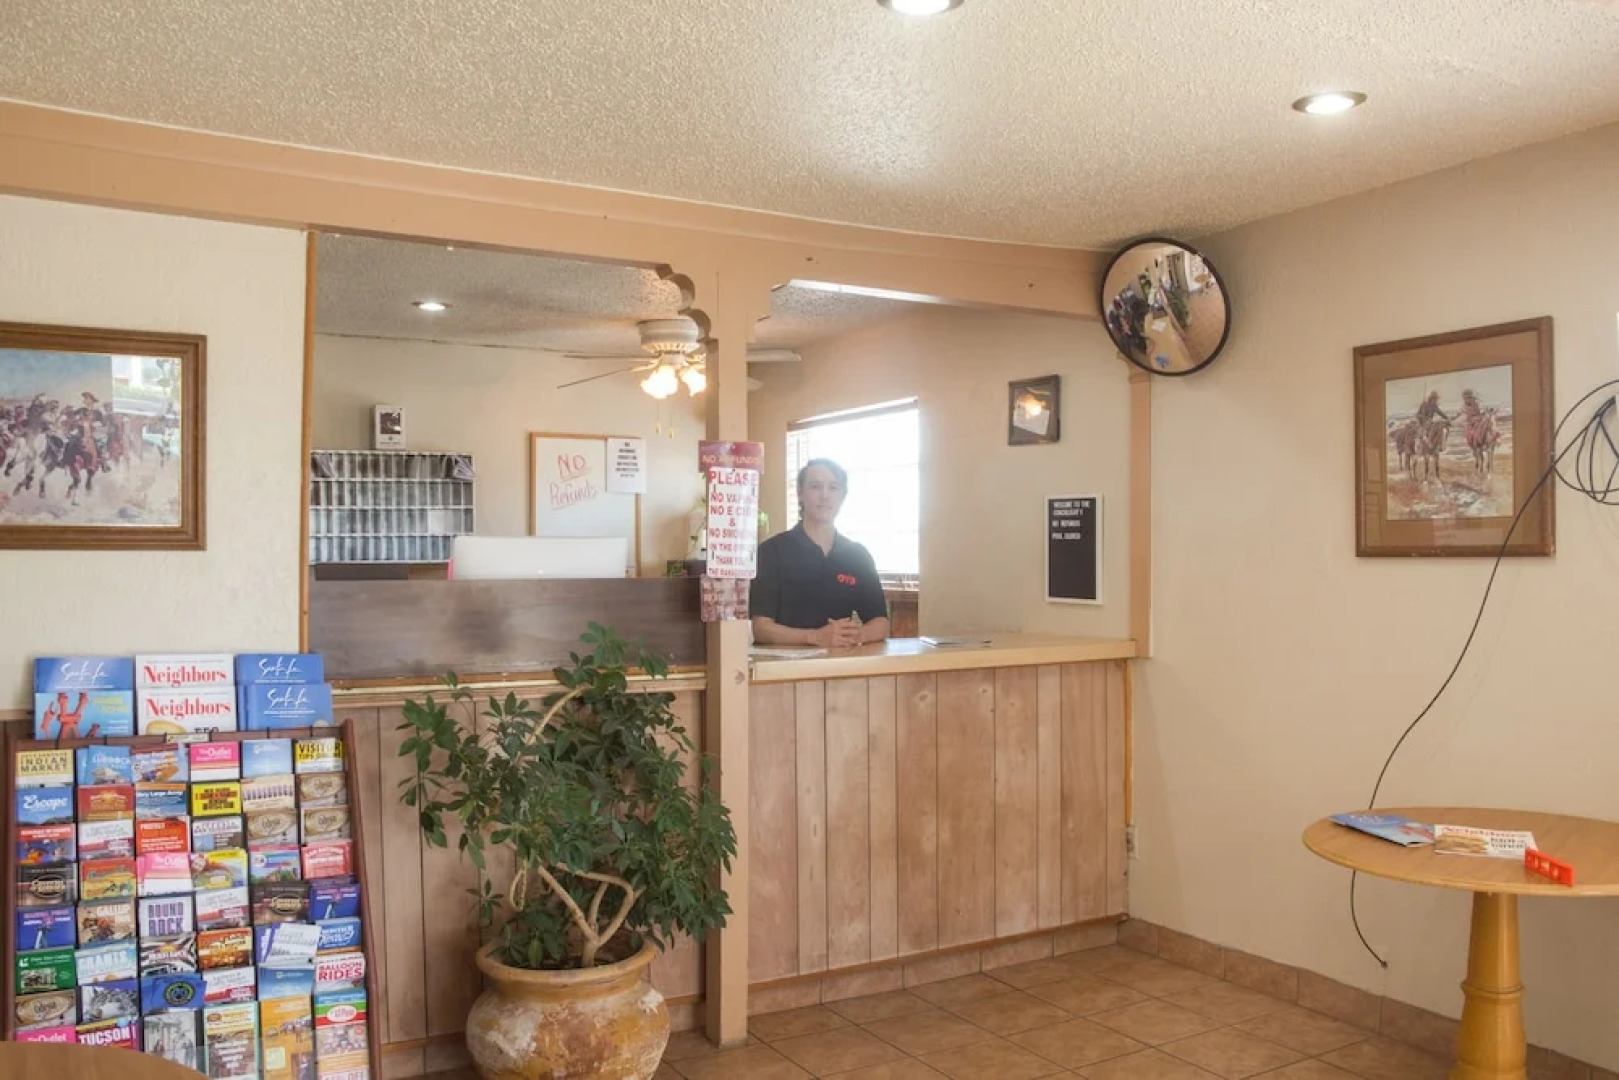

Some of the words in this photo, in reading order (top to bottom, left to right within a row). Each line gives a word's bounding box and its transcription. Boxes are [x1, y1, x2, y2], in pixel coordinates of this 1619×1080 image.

[557, 454, 587, 479] NO
[718, 455, 760, 464] RFUNDS
[708, 471, 757, 485] PLEASE
[710, 491, 724, 503] NO
[710, 505, 724, 516] NO
[709, 528, 721, 539] NO
[143, 665, 228, 687] Neighbors
[146, 698, 231, 720] Neighbors
[20, 756, 67, 765] INDIAN
[20, 764, 66, 772] MARKET
[23, 794, 68, 810] Escape
[148, 916, 183, 937] ROCK
[318, 960, 362, 971] BALLOON
[318, 967, 363, 982] RIDES
[78, 1027, 131, 1045] TUCSON
